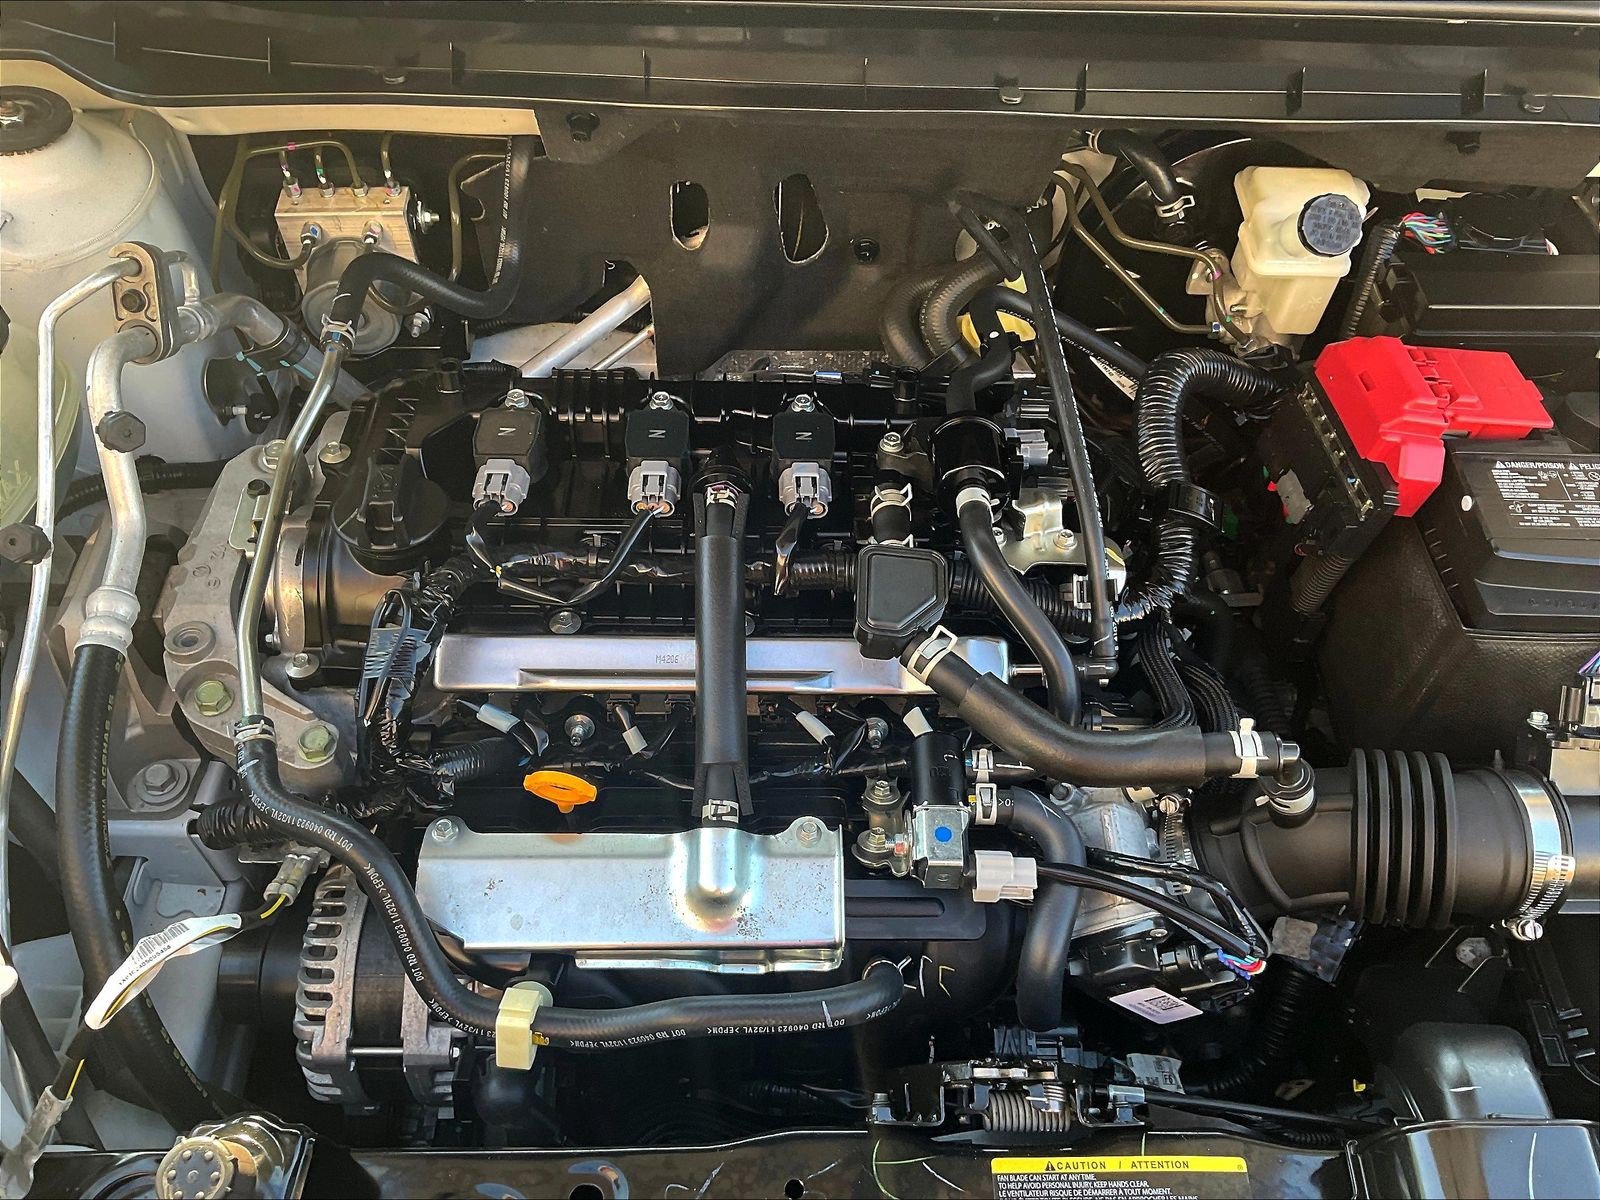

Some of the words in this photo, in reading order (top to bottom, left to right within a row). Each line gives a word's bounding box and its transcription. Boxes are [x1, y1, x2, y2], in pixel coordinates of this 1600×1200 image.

[296, 818, 324, 834] 040923
[336, 836, 353, 851] DOT
[394, 924, 412, 952] 040923
[411, 967, 425, 982] DOT
[671, 1028, 686, 1038] DOT
[778, 1023, 809, 1033] 040923
[627, 1033, 655, 1045] 040923
[1057, 1161, 1106, 1170] CAUTION
[1130, 1161, 1189, 1169] ATTENTION
[997, 1174, 1009, 1182] FAN
[998, 1182, 1007, 1190] TO
[1041, 1181, 1072, 1189] PERSONAL
[1108, 1180, 1129, 1188] HANDS
[1129, 1180, 1150, 1188] CLEAR.
[1049, 1189, 1072, 1197] RISQUE
[1124, 1188, 1142, 1196] TOUT
[1142, 1187, 1173, 1196] MOMENT.
